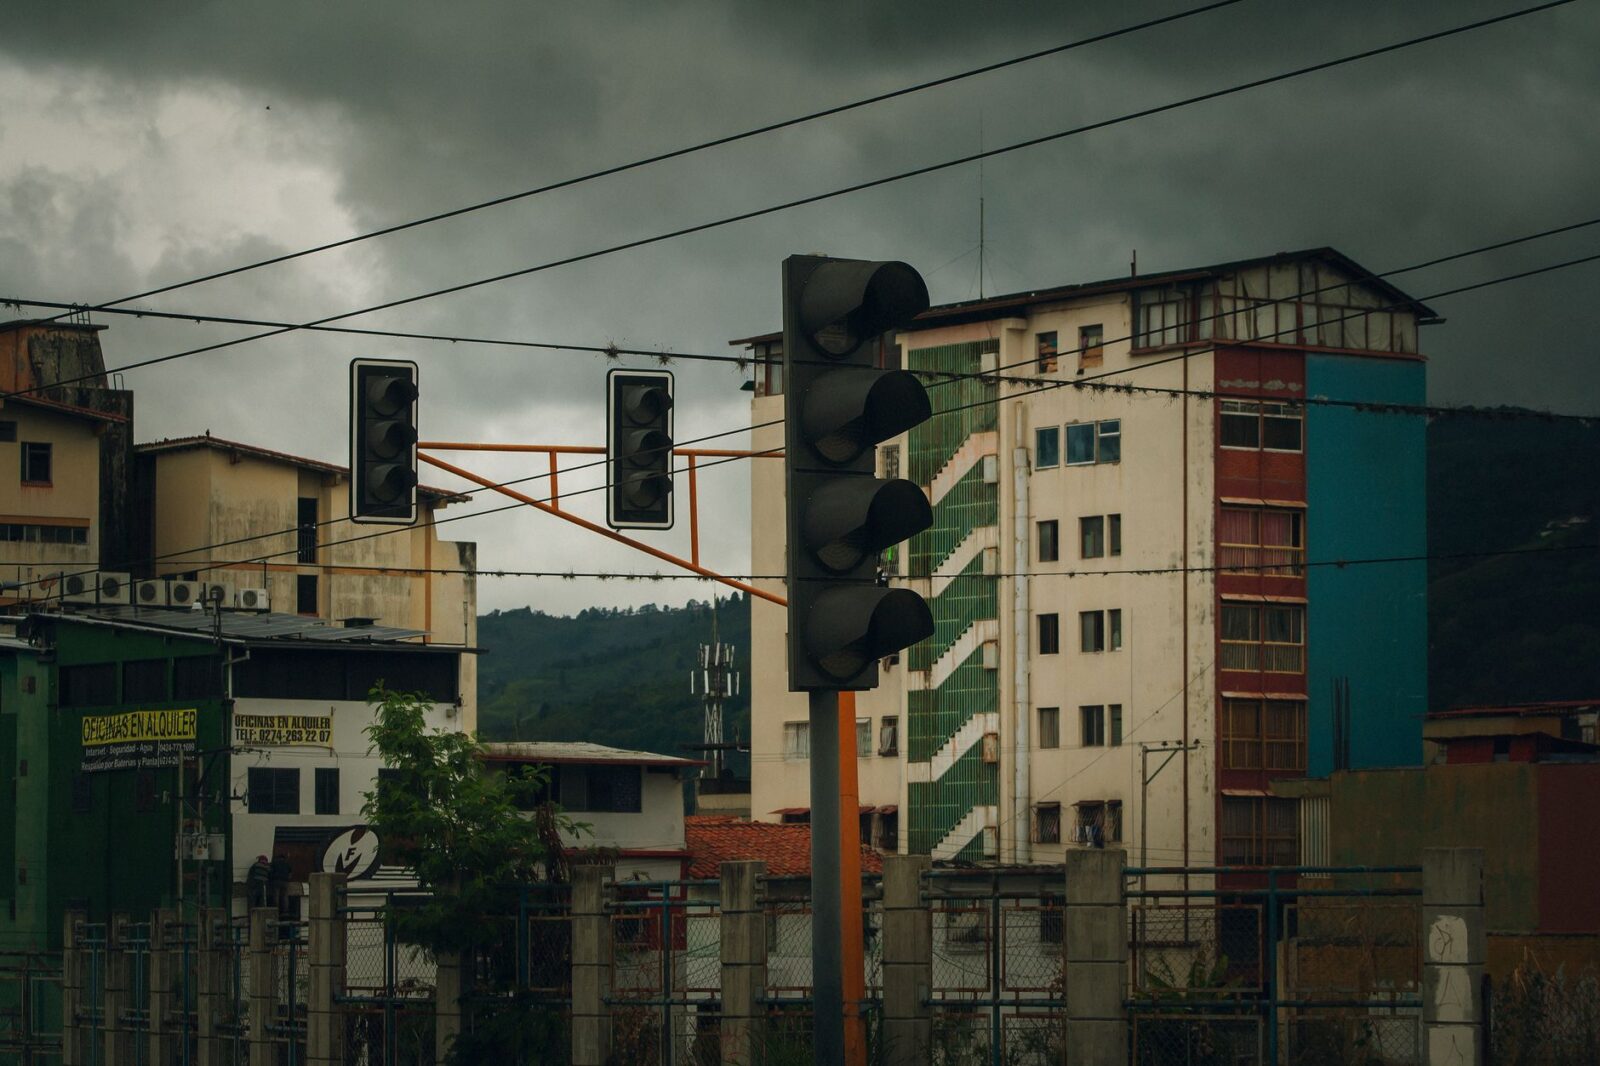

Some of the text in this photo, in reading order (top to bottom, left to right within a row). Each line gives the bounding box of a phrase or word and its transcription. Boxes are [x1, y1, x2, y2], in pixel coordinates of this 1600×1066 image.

[83, 711, 195, 741] OFICINAS EN ALQUILER
[234, 715, 330, 729] OFICINAS EN ALQUILER
[305, 730, 316, 742] 22
[319, 730, 331, 742] 07
[109, 744, 136, 756] Seguridad
[140, 743, 153, 754] Agua
[104, 761, 113, 770] por
[138, 760, 141, 768] y
[142, 757, 157, 765] Planta
